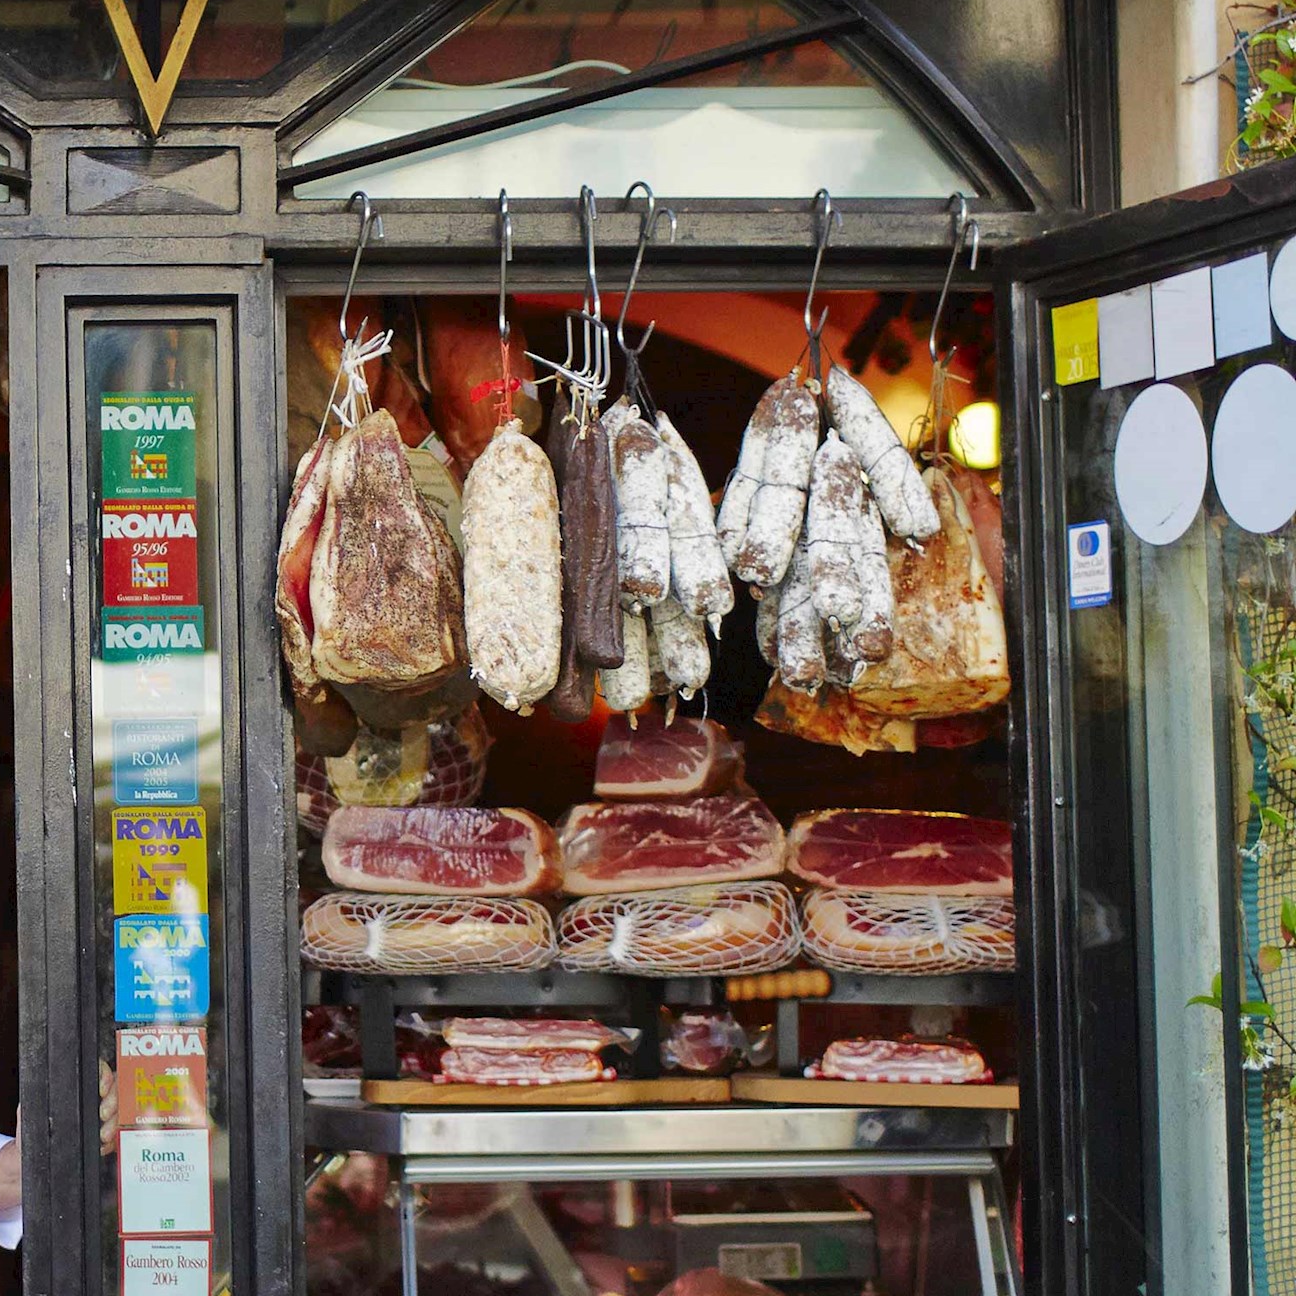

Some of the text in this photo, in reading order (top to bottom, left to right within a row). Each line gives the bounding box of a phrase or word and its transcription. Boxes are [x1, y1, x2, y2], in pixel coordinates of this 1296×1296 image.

[101, 405, 196, 431] ROMA
[134, 435, 164, 449] 1997
[102, 513, 197, 539] ROMA
[131, 542, 169, 557] 95/96
[105, 623, 203, 649] ROMA
[136, 653, 172, 666] 94/95
[132, 751, 181, 766] ROMA
[143, 777, 169, 787] 2005
[116, 818, 203, 840] ROMA
[139, 844, 180, 856] 1999
[119, 925, 207, 949] ROMA
[120, 1034, 205, 1057] ROMA
[165, 1067, 190, 1076] 2001
[142, 1148, 186, 1162] Roma
[133, 1162, 195, 1173] del Gambero
[126, 1254, 208, 1269] Gambero Rosso
[152, 1272, 178, 1285] 2004
